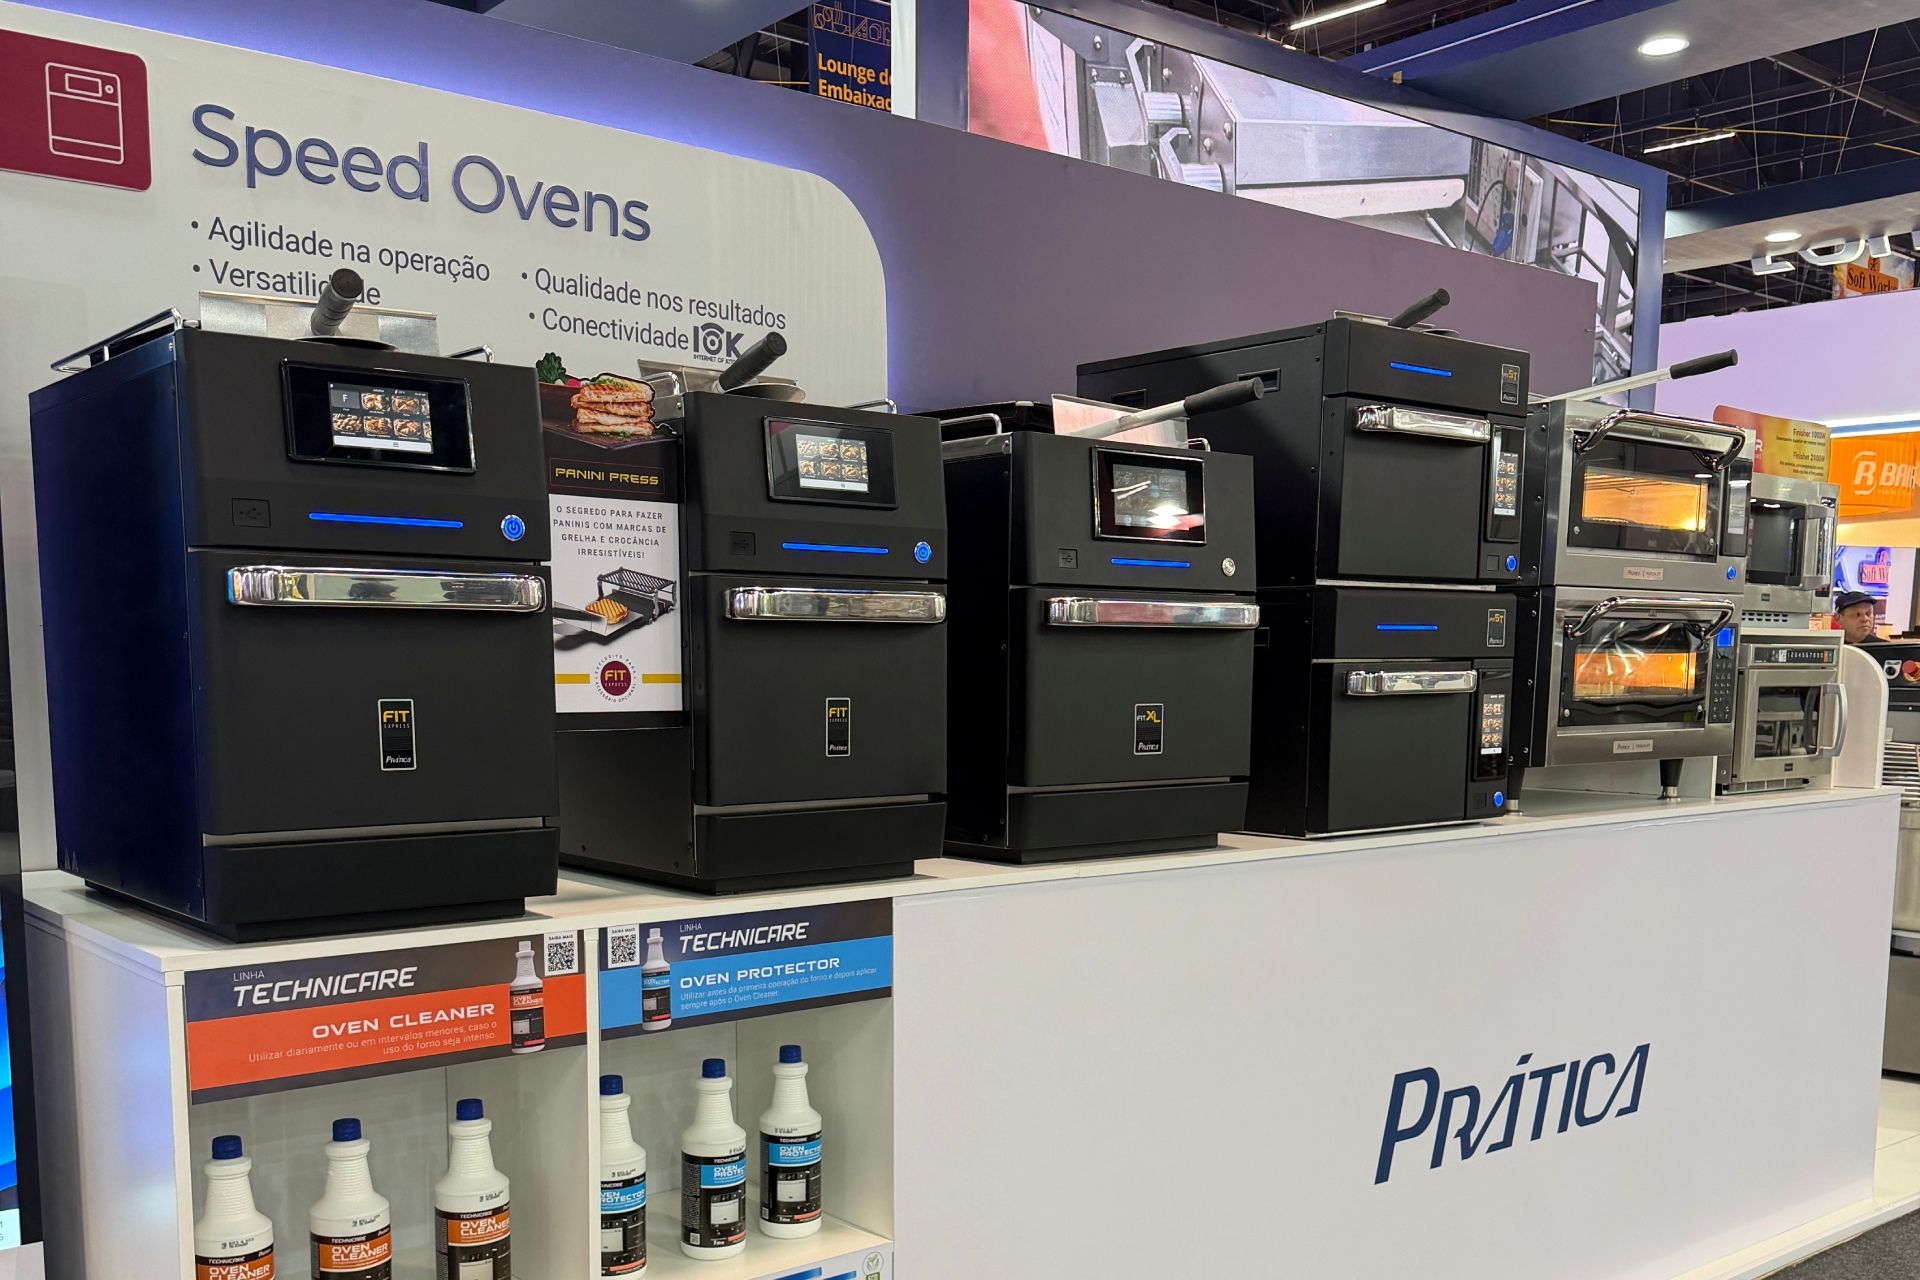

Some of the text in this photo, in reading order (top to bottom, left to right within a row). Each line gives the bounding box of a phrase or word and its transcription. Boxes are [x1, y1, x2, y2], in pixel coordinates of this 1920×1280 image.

[818, 52, 891, 86] Lounge d
[192, 104, 650, 241] Speed Ovens
[208, 217, 490, 282] Agilidade na operação
[209, 259, 380, 304] Versatilie
[1848, 267, 1865, 289] Soft
[536, 268, 786, 330] Qualidade nos resultados
[542, 308, 688, 350] Conectividade
[555, 468, 659, 485] PANINI PRESS
[566, 506, 606, 516] SEGREDO
[610, 510, 633, 518] PARA
[636, 512, 663, 520] FAZER
[553, 520, 590, 528] PANINIS
[594, 522, 613, 530] COM
[616, 524, 653, 532] MARCAS
[562, 534, 597, 542] GRELHA
[609, 536, 659, 546] CROCÂNCIA
[578, 548, 645, 558] IRRESISTÍVEIS!
[605, 670, 626, 681] FIT
[383, 710, 409, 722] FIT
[829, 708, 848, 717] FIT
[1146, 710, 1161, 723] XL
[680, 923, 702, 932] LINHA
[680, 922, 809, 953] TECHNICARE
[234, 970, 264, 981] LINHA
[680, 972, 729, 989] OVEN
[737, 958, 840, 980] PROTECTOR
[233, 967, 418, 1007] TECHNICARE
[681, 992, 706, 1000] Utilizar
[708, 988, 726, 996] antes
[738, 983, 766, 992] primeira
[834, 971, 854, 979] depois
[681, 1001, 707, 1010] sempre
[734, 994, 751, 1002] Oven
[753, 990, 778, 999] Cleaner
[313, 1004, 495, 1038] OVEN CLEANER
[249, 1052, 283, 1062] Utilizar
[287, 1043, 344, 1057] diariamente
[379, 1032, 423, 1043] intervalos
[468, 1023, 490, 1031] caso
[402, 1043, 414, 1052] do
[416, 1039, 440, 1049] forno
[443, 1037, 460, 1047] seja
[1374, 1042, 1650, 1185] PRÁTICA
[461, 1217, 496, 1228] OVEN
[332, 1243, 370, 1254] OVEN
[332, 1243, 388, 1262] CLEANER
[209, 1264, 249, 1275] OVEN
